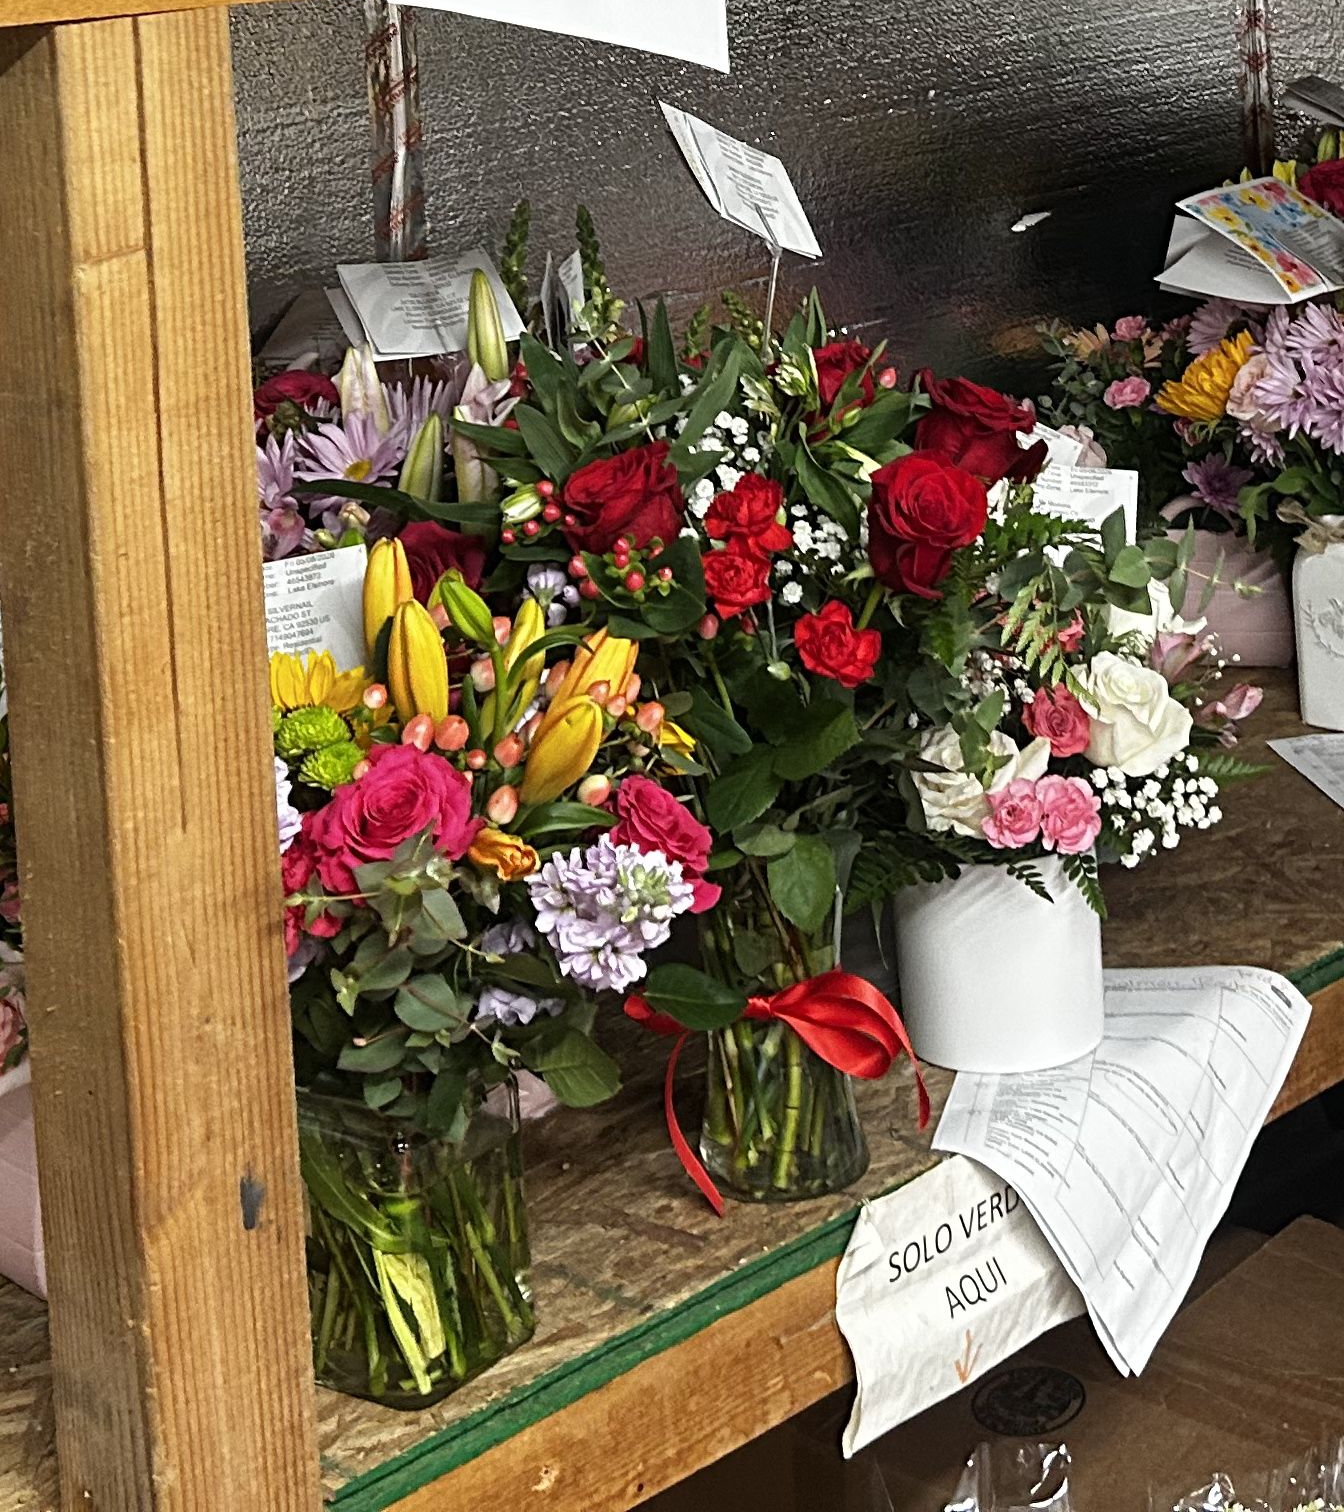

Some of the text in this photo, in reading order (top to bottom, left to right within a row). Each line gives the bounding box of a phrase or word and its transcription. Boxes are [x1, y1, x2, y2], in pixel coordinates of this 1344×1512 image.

[288, 584, 306, 594] Lake
[888, 1186, 1020, 1283] SOLO VERD
[945, 1256, 1008, 1319] AQUI
